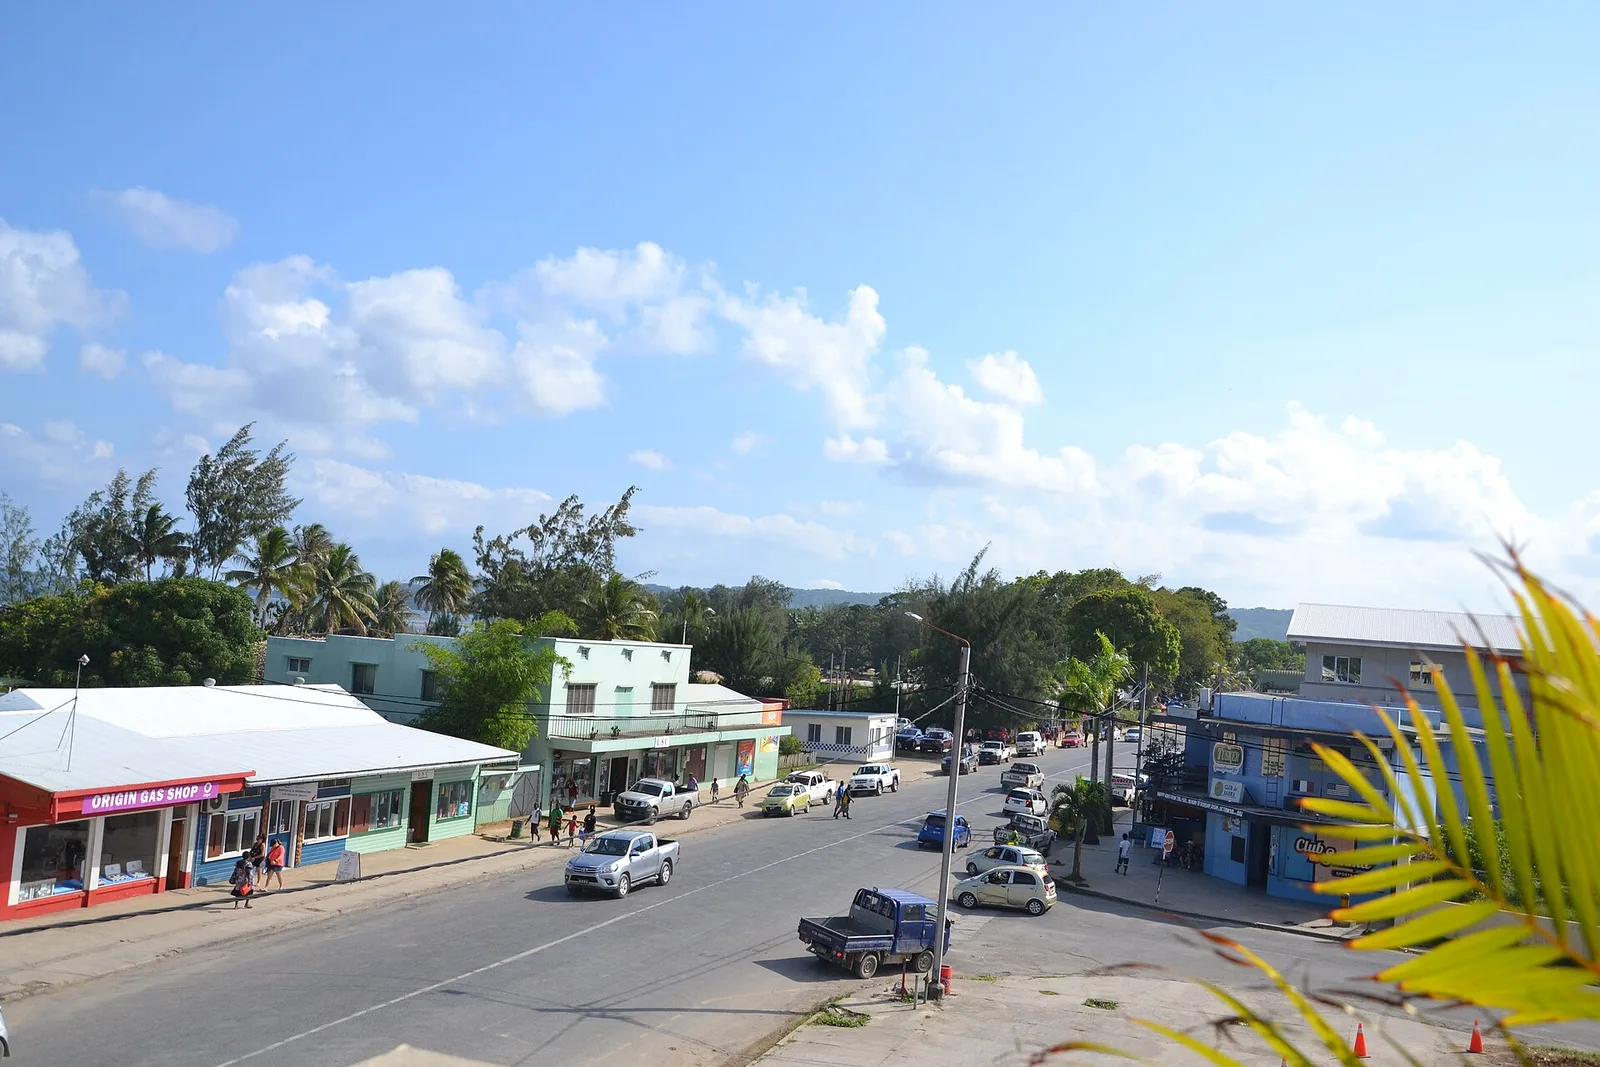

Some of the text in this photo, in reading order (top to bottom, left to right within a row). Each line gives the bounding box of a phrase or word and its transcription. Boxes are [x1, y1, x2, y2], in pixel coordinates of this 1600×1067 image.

[1216, 748, 1240, 762] TUSKER
[92, 785, 198, 809] ORIGIN GAS SHOP
[1295, 838, 1324, 854] Club
